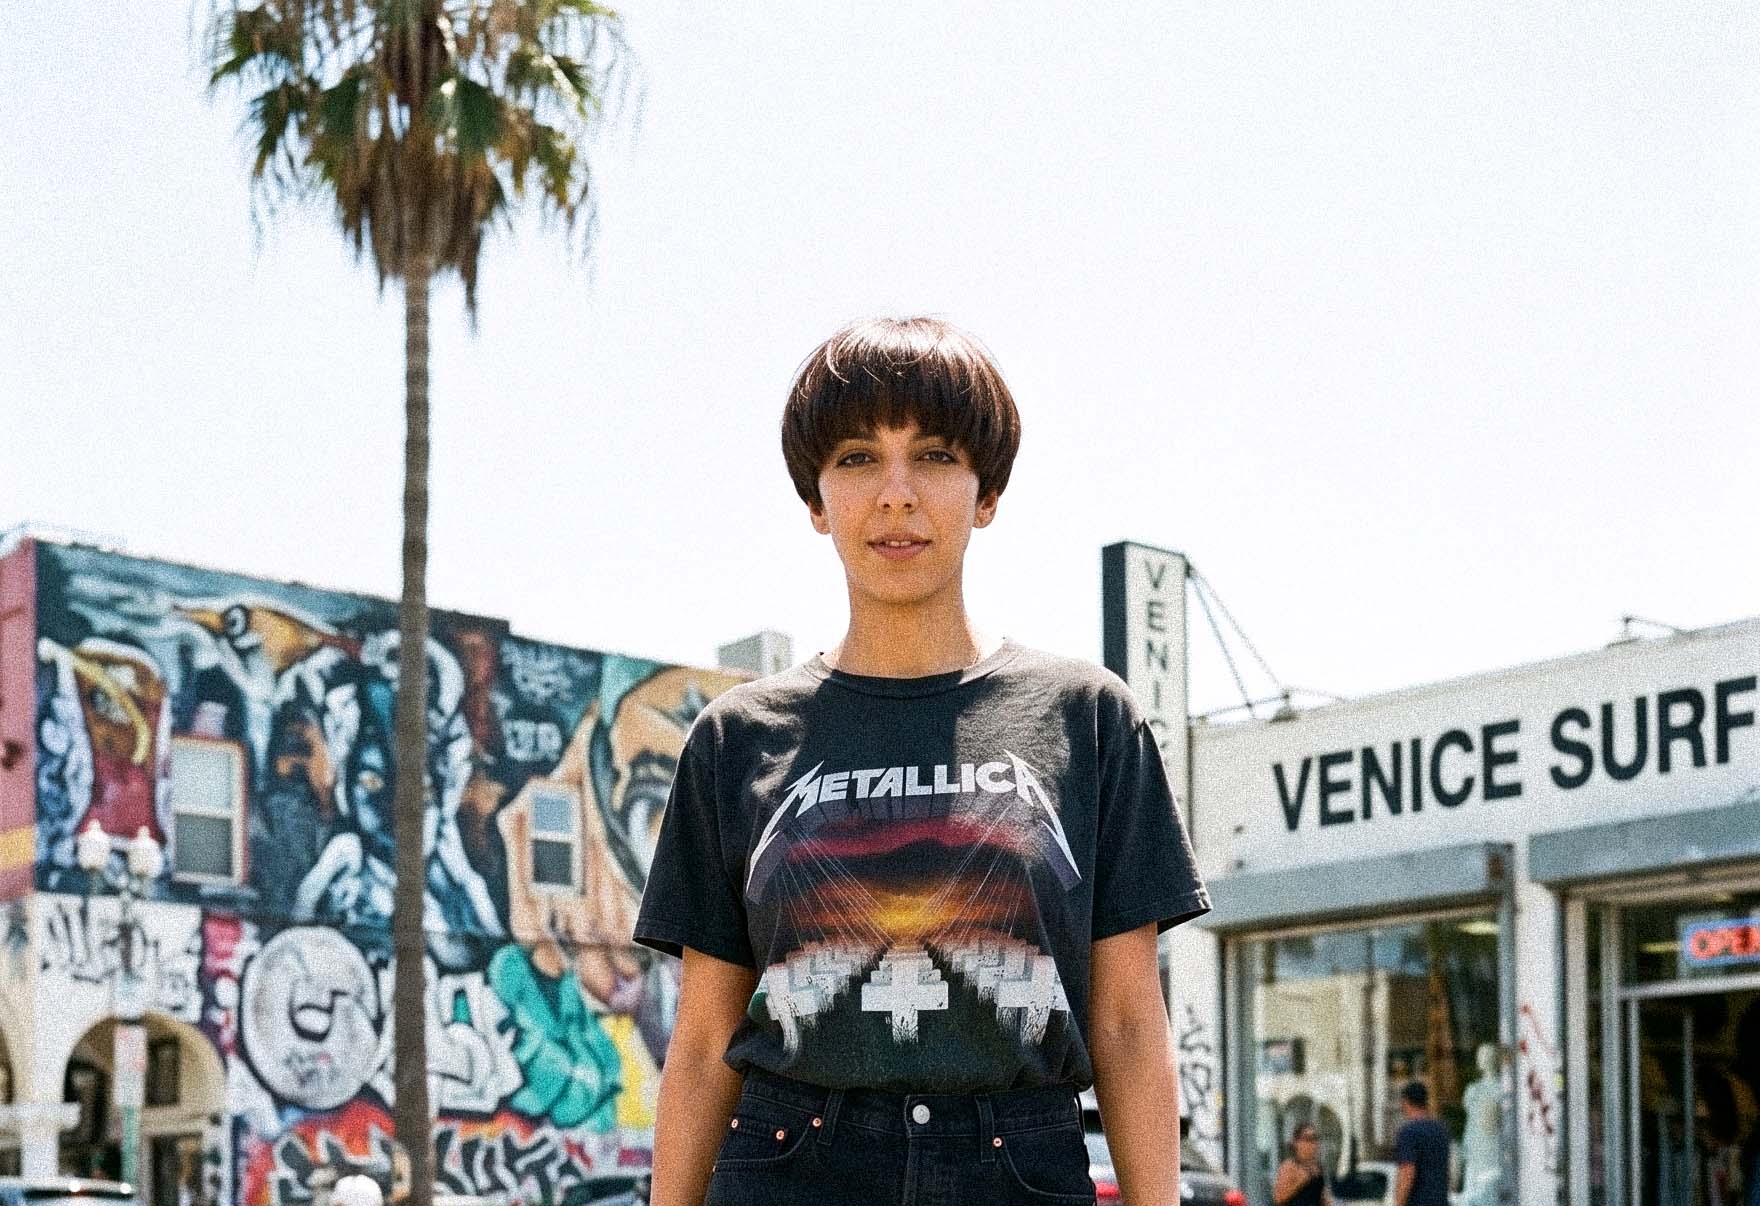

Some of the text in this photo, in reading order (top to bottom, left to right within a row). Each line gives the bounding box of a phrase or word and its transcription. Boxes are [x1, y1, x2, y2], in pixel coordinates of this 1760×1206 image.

[1144, 560, 1169, 766] VENIC
[746, 749, 1081, 893] METALLICA
[1273, 676, 1757, 832] VENICE SURF
